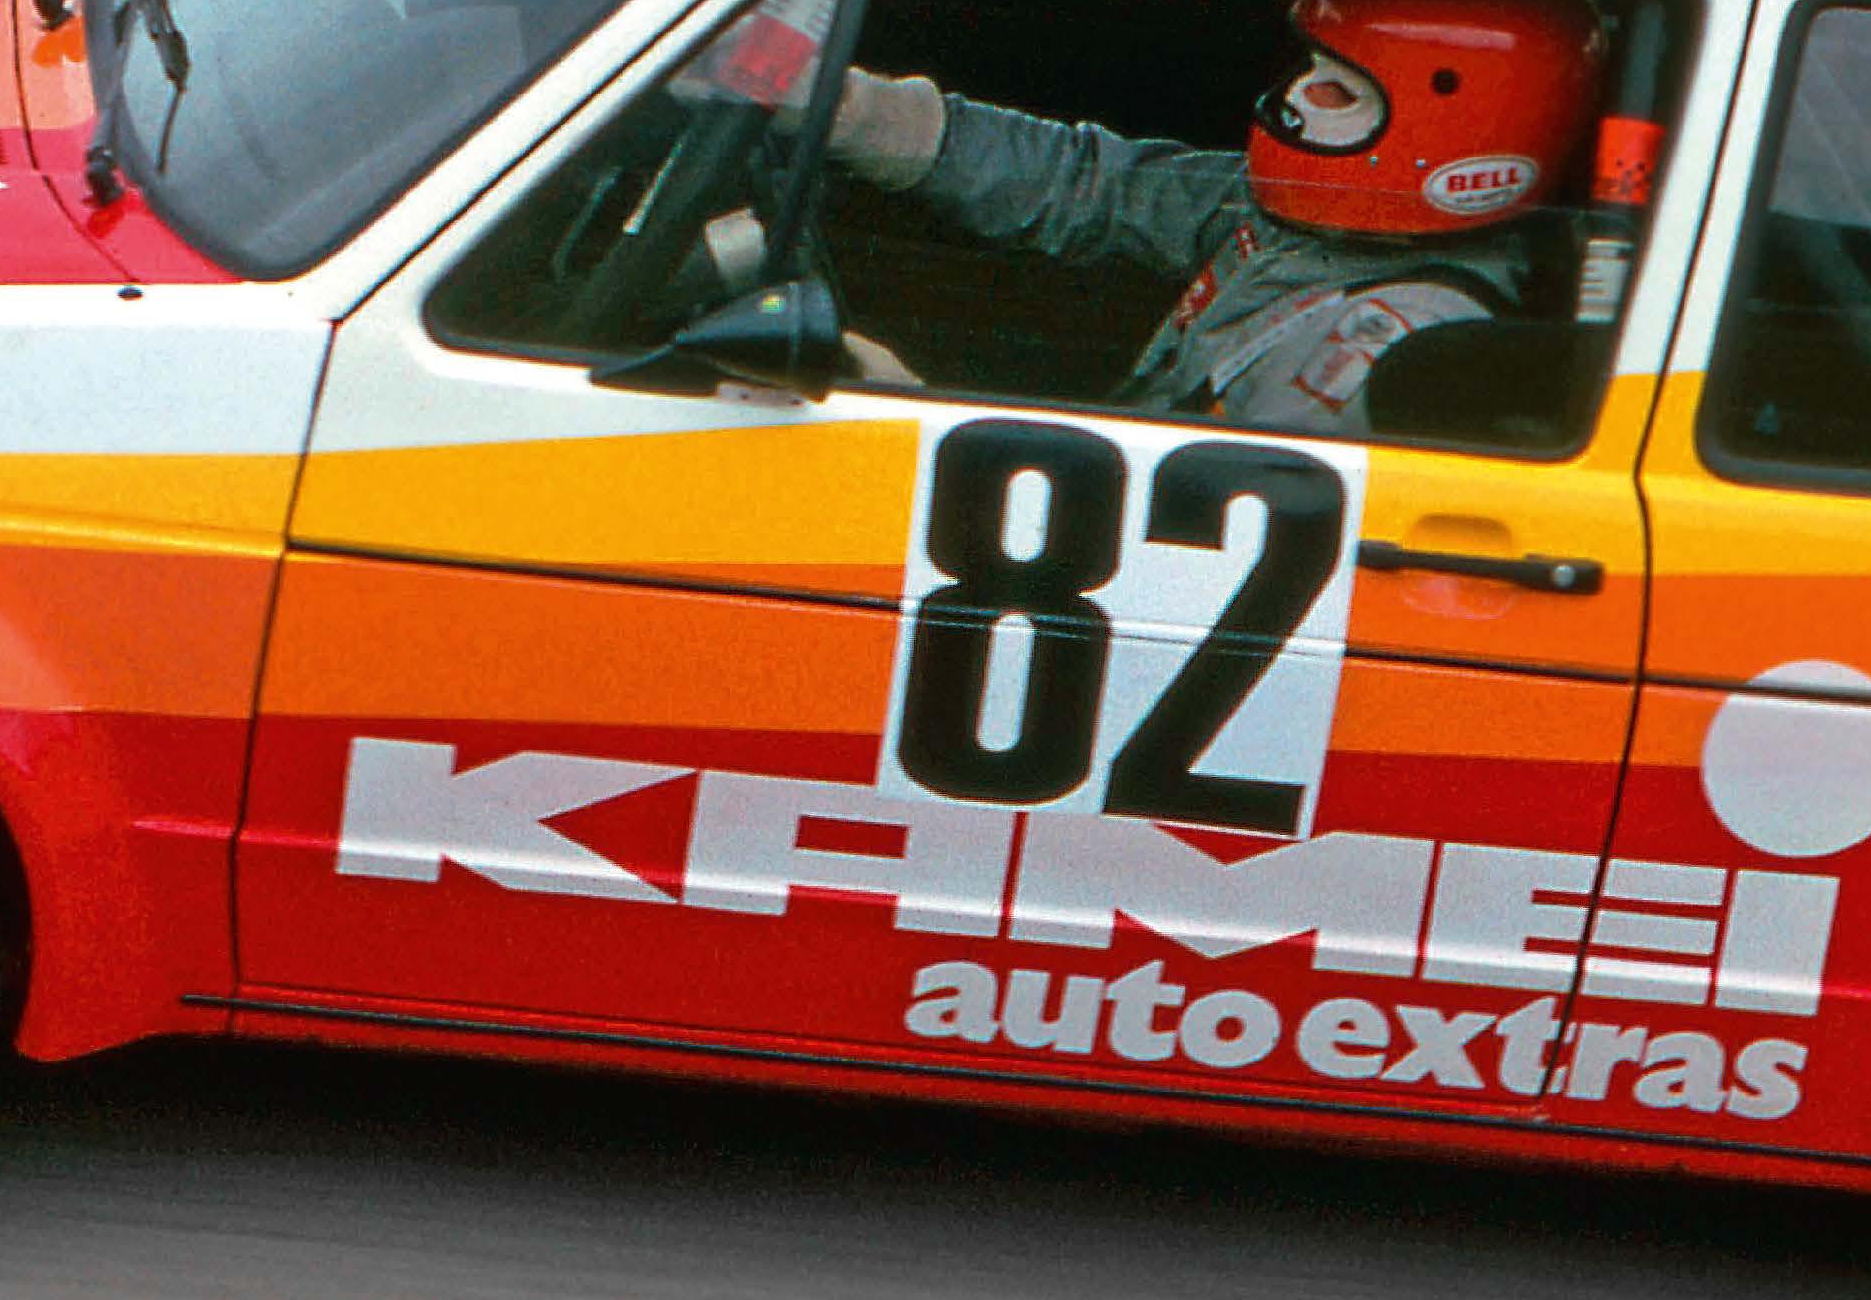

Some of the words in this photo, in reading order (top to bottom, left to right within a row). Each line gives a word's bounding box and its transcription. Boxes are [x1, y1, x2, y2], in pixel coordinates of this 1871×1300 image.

[1447, 167, 1521, 192] BELL
[894, 417, 1350, 833] 82
[904, 955, 1293, 1072] auto
[1298, 984, 1808, 1120] extras
